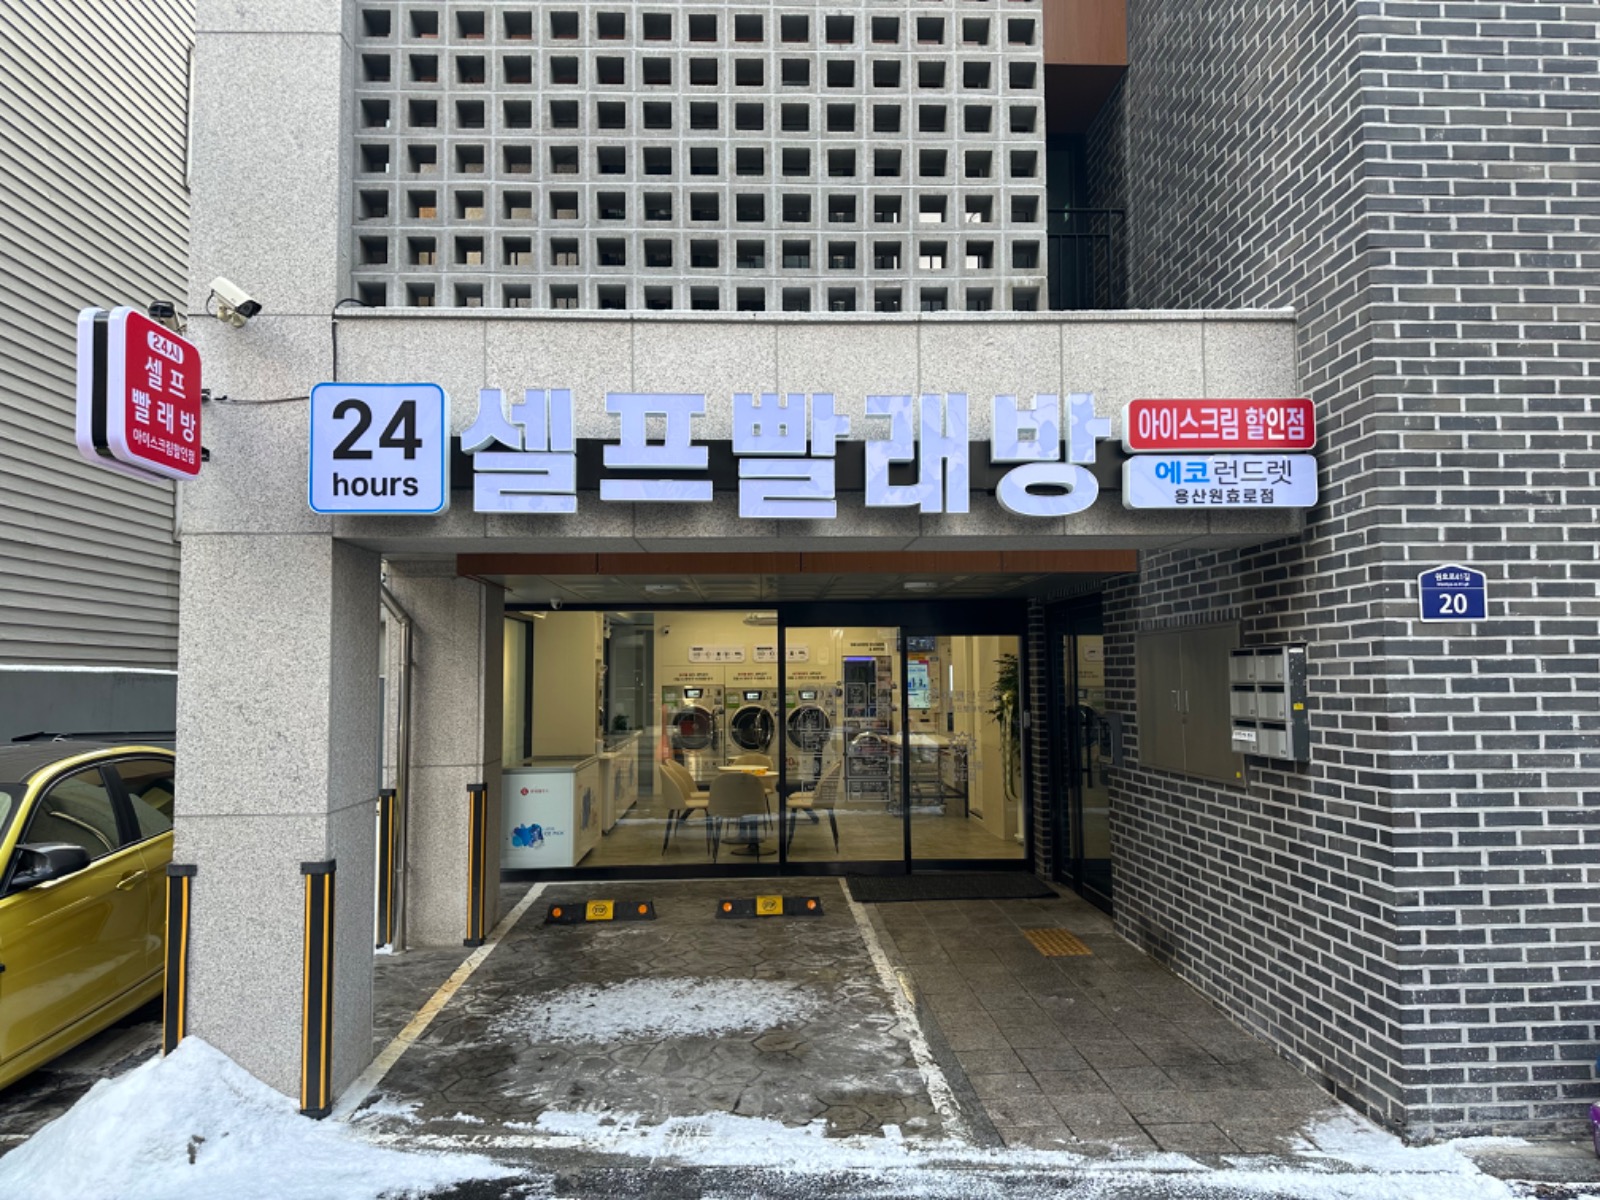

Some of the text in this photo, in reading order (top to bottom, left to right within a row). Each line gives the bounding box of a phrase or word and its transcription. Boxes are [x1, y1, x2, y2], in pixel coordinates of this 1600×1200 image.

[152, 334, 181, 362] 24시
[131, 388, 197, 443] 빨래방
[332, 398, 423, 461] 24
[1138, 407, 1305, 441] 아이스크림 할인점
[132, 428, 196, 465] 아이스크림할인점
[460, 388, 1112, 519] 셀프빨래방
[332, 472, 419, 497] hours
[1174, 488, 1275, 505] 용산원효로점
[1439, 593, 1468, 614] 20
